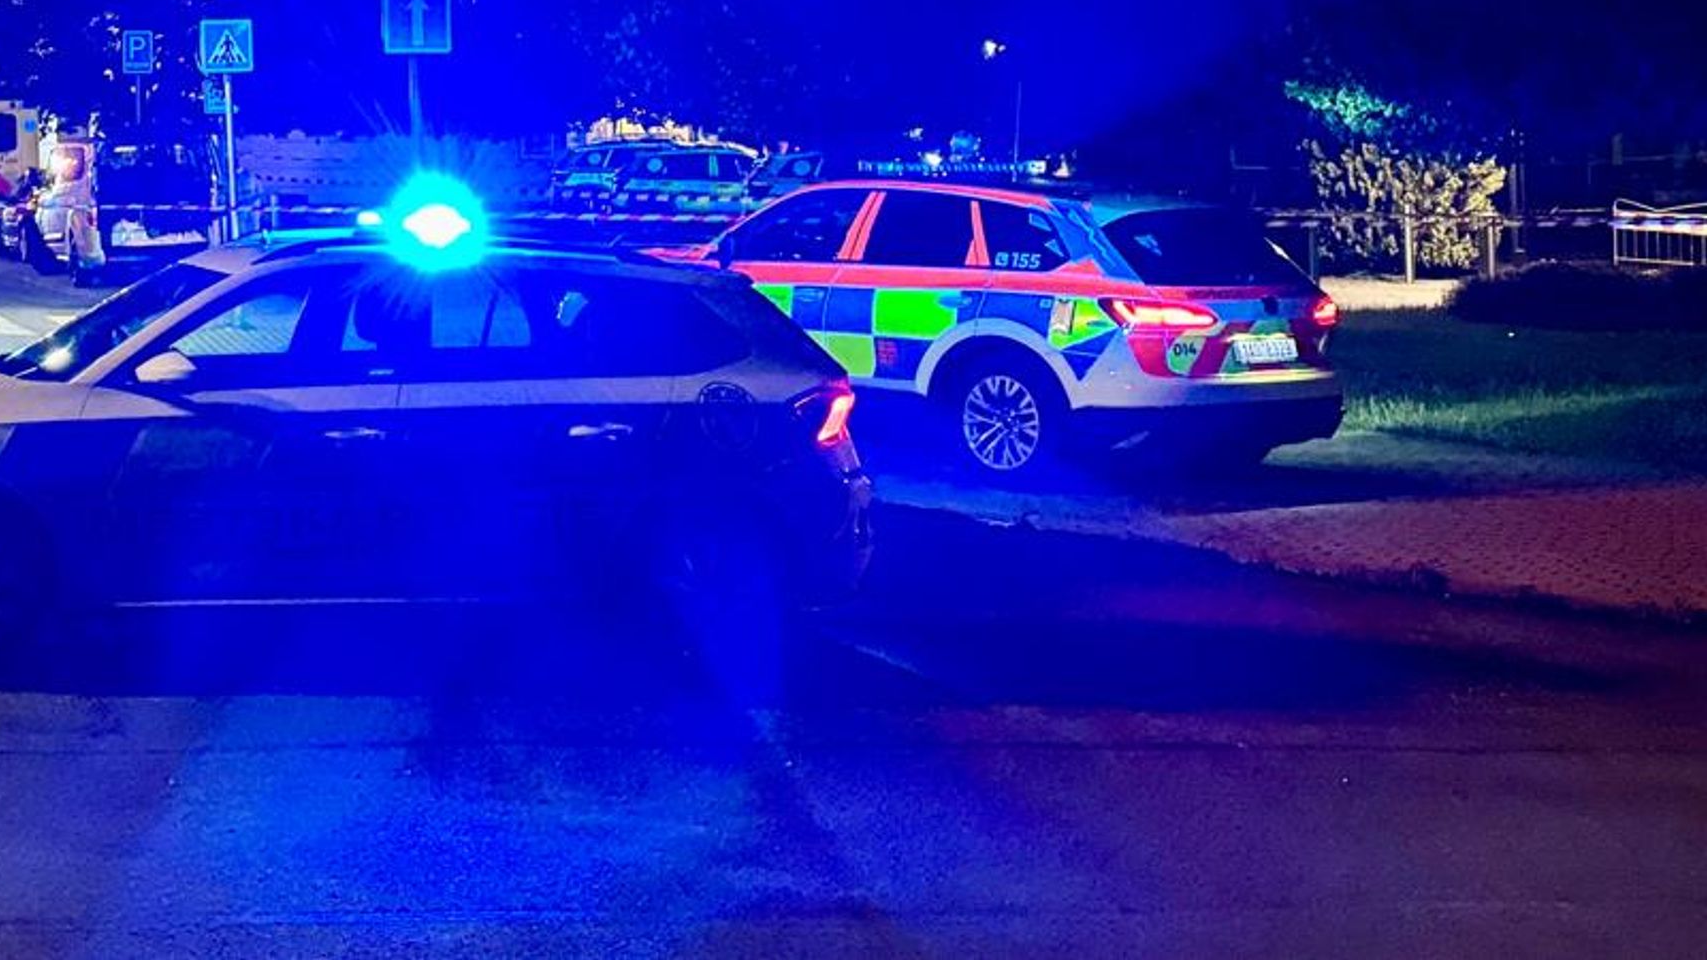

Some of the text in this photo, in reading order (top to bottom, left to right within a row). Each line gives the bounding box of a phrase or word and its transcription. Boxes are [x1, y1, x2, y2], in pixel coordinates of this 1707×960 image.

[129, 35, 147, 60] P
[1011, 251, 1042, 269] 155
[1172, 342, 1197, 356] 014
